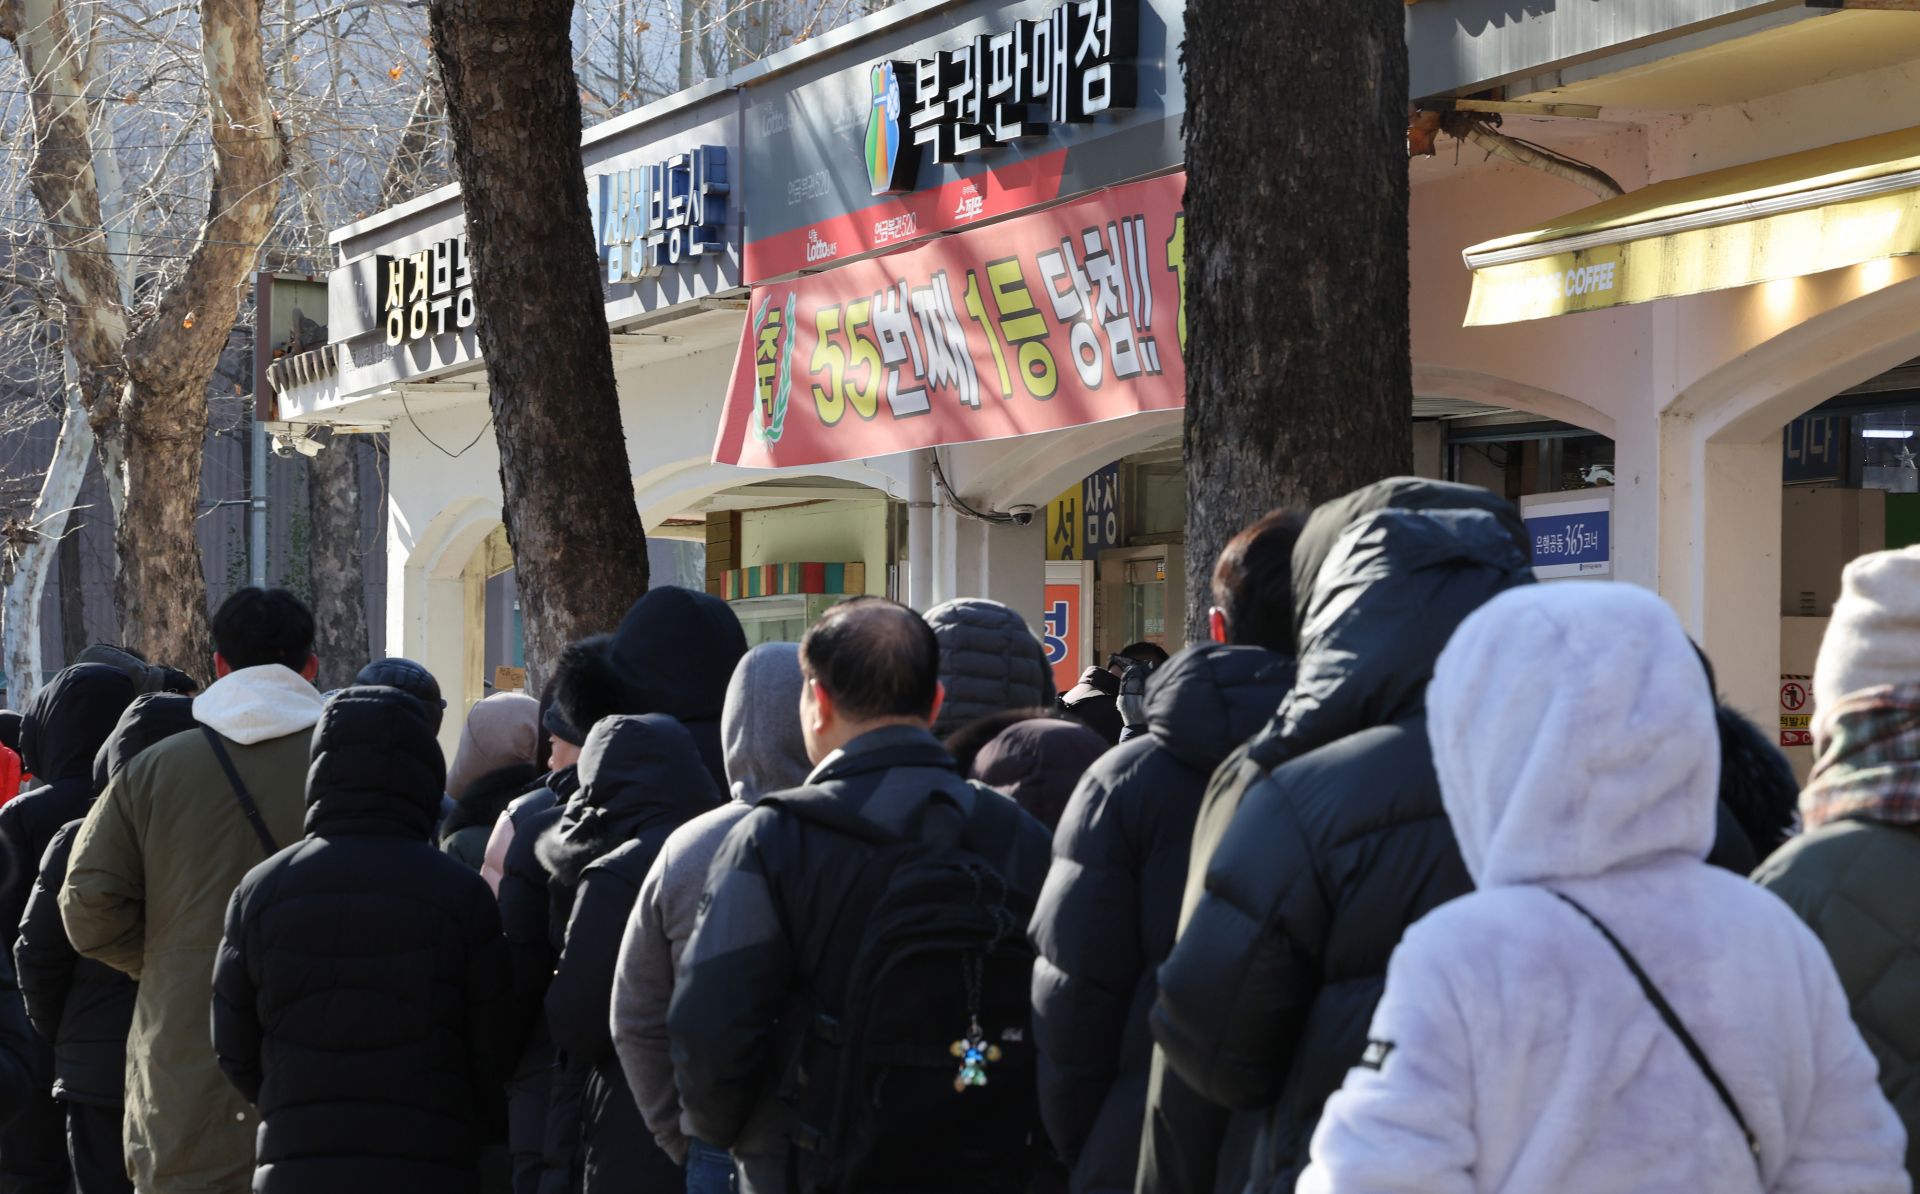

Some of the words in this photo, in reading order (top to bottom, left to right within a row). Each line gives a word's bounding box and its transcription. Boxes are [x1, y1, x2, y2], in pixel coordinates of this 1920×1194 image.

[910, 1, 1112, 165] 복권판매점
[604, 146, 714, 283] 삼성부동산
[874, 212, 917, 244] 연금복권520
[756, 307, 783, 417] 축
[809, 270, 981, 427] 55번째
[964, 256, 1058, 400] 1등
[1036, 214, 1163, 390] 당첨!!
[1565, 261, 1616, 297] COFFEE
[1084, 472, 1118, 545] 삼성
